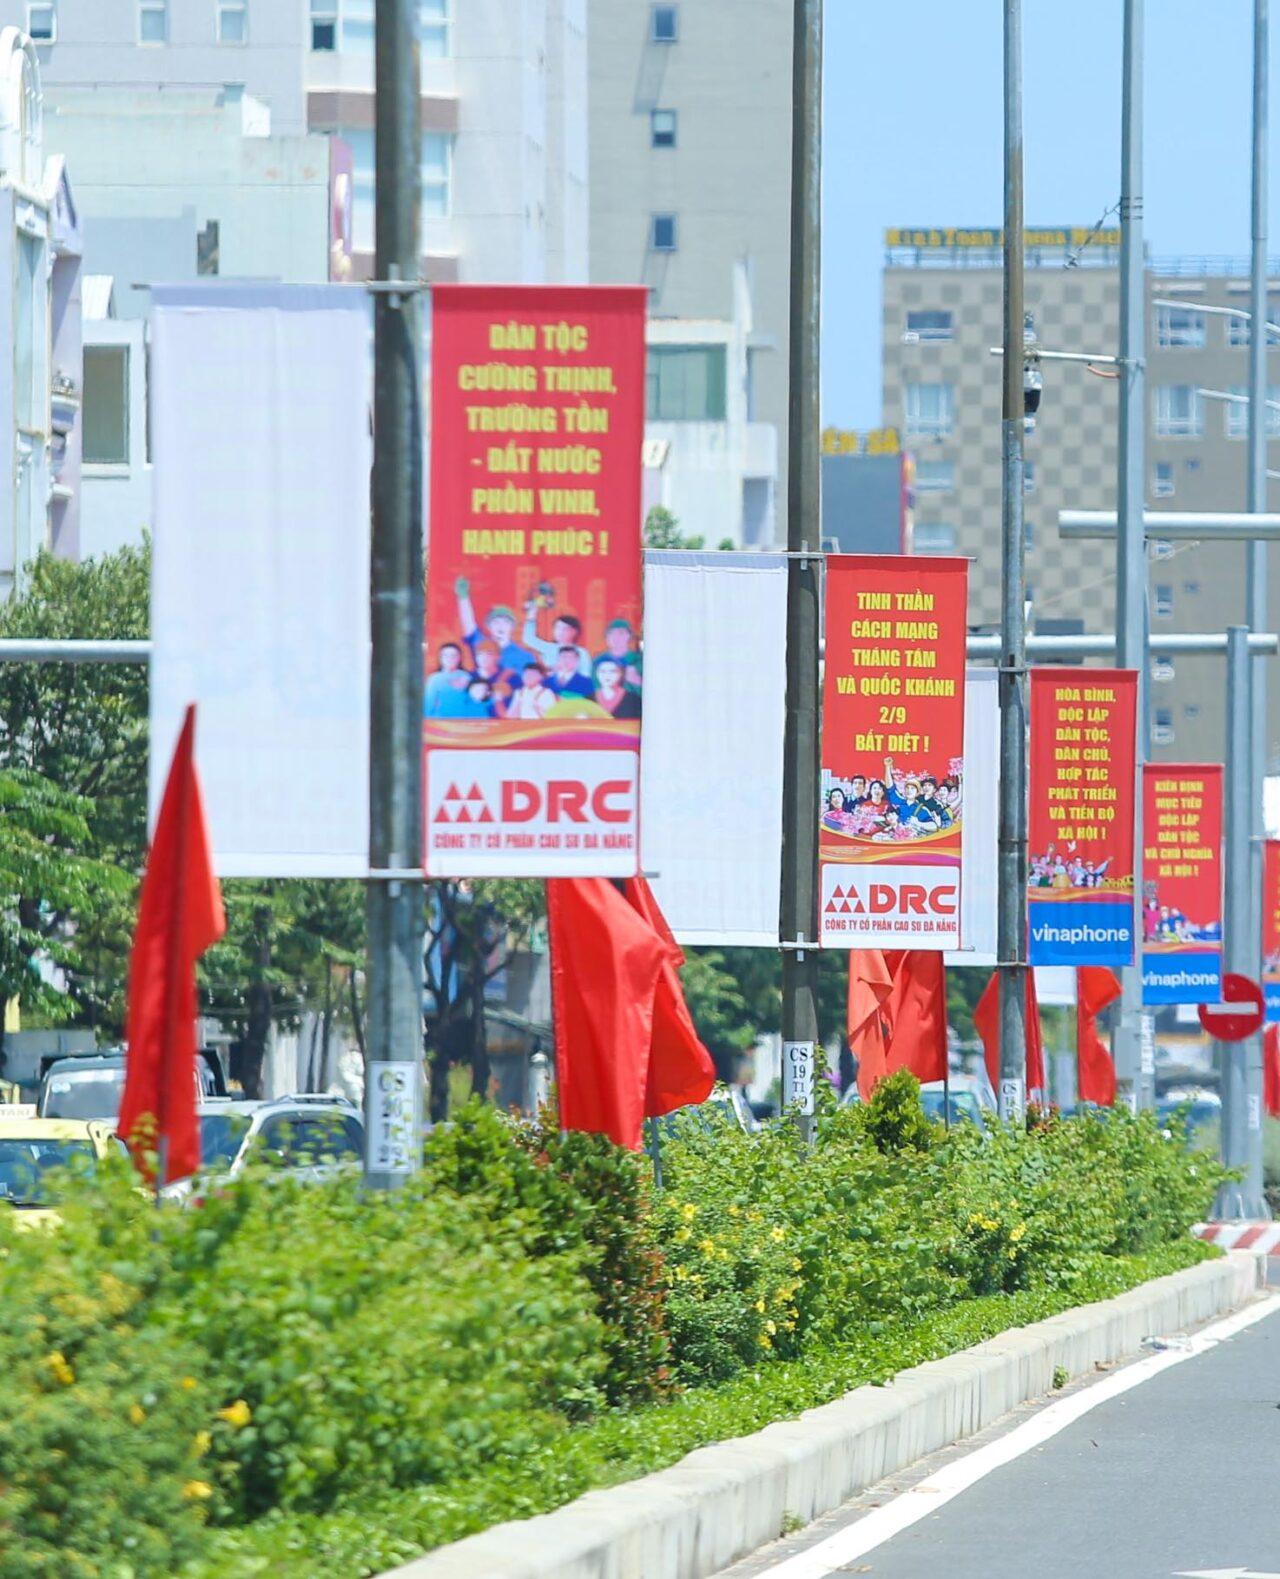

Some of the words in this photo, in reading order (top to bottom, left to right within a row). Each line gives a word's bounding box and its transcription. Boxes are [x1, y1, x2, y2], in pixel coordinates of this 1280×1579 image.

[857, 593, 891, 611] TINH
[896, 589, 934, 612] THẦN
[851, 619, 891, 638] CÁCH
[896, 622, 938, 642] MẠNG
[852, 647, 900, 666] THÁNG
[905, 648, 936, 668] TÁM
[836, 675, 856, 695] VÀ
[860, 672, 901, 696] QUỐC
[905, 676, 954, 697] KHÁNH
[879, 706, 906, 724] 2/9
[855, 729, 884, 752] BẤT
[888, 733, 919, 755] DIỆT
[501, 780, 632, 823] DRC
[869, 884, 957, 914] DRC
[1032, 923, 1130, 945] vinaphone
[1142, 971, 1219, 988] vinaphone
[790, 1047, 808, 1062] CS
[792, 1065, 806, 1079] 19
